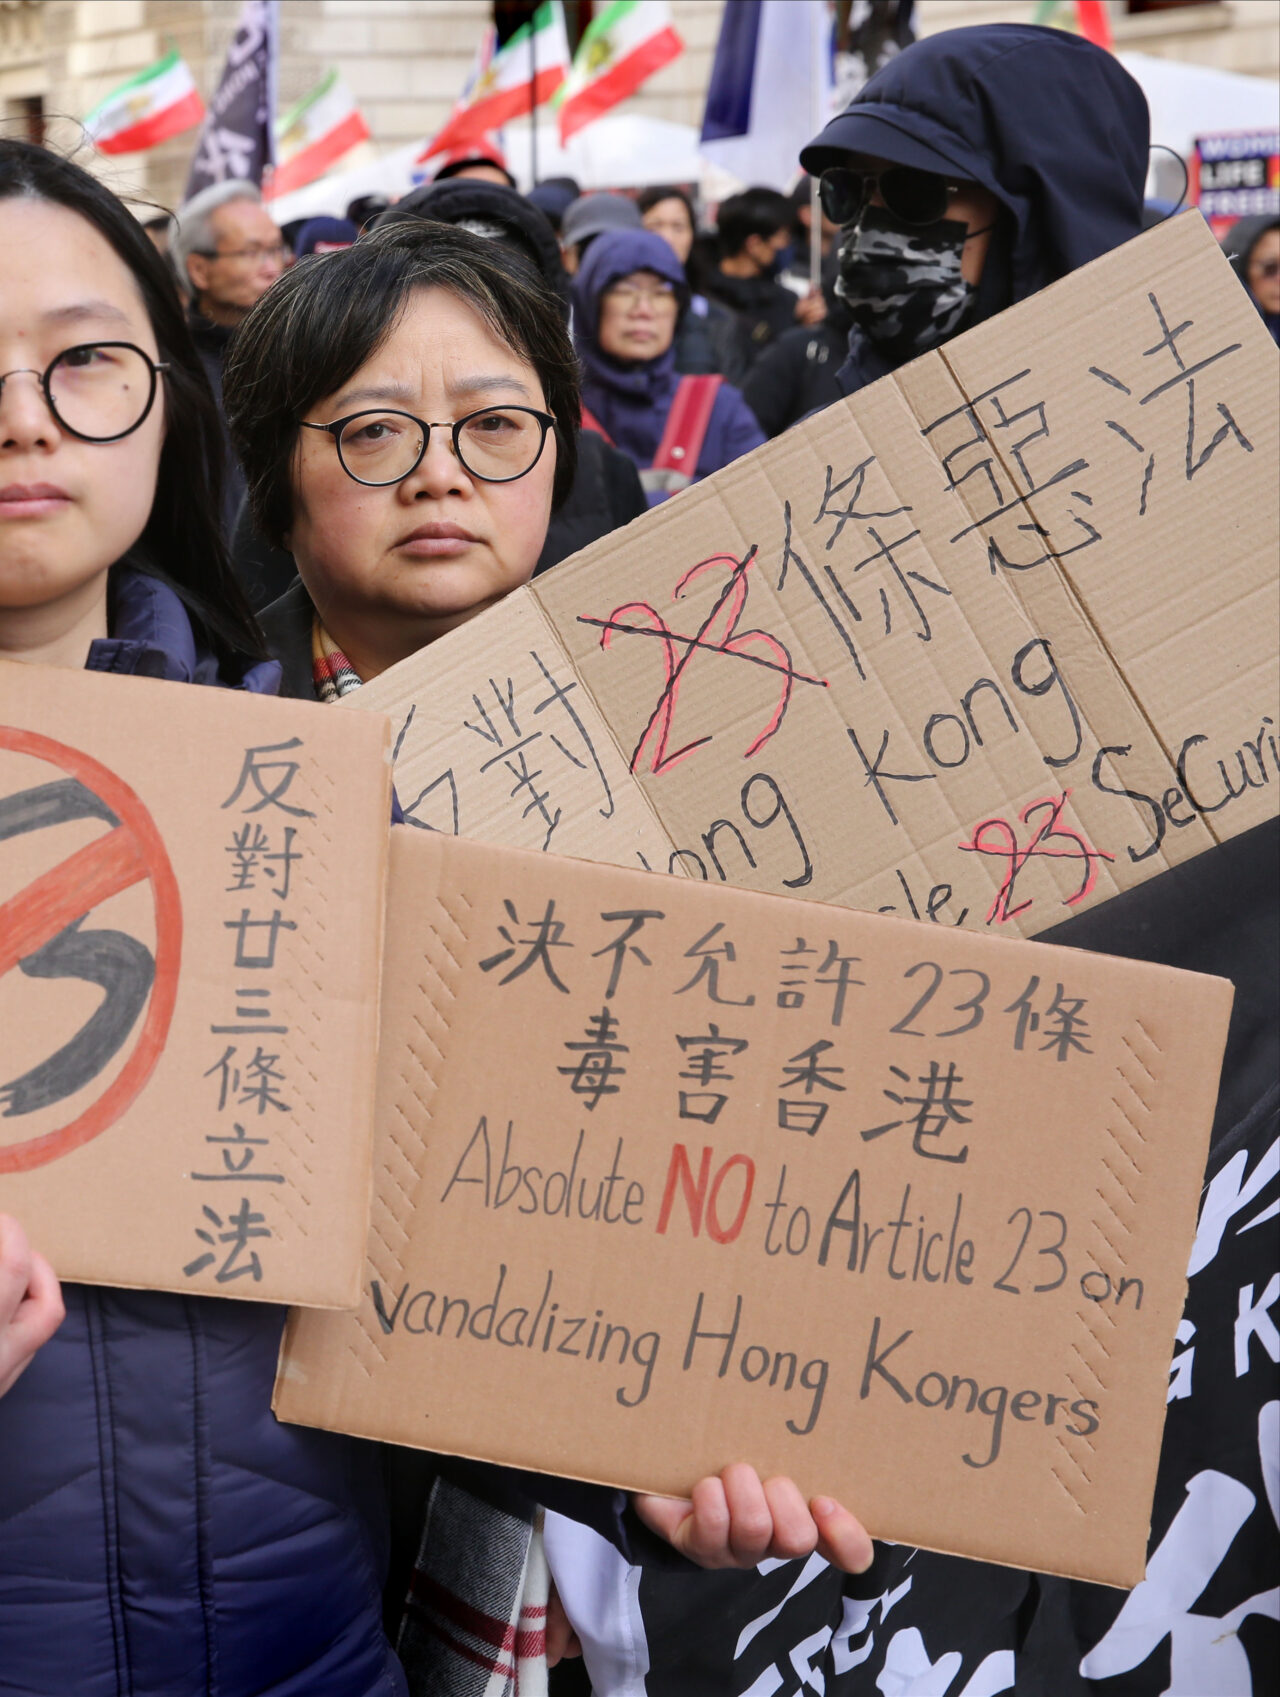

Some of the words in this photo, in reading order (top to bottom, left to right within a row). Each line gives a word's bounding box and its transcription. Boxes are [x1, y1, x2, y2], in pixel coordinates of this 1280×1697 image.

[635, 774, 814, 887] ong
[848, 638, 1082, 826] Kong
[183, 737, 318, 1284] 反對廿三條立法
[556, 1005, 974, 1164] 毒害香港
[441, 1115, 645, 1225] Absolute
[655, 1143, 756, 1245] NO
[765, 1164, 811, 1256] to
[817, 1168, 976, 1285] Article
[992, 1208, 1068, 1294] 23
[1079, 1270, 1146, 1311] on
[682, 1291, 830, 1435] Hong
[859, 1316, 1101, 1469] Kongers
